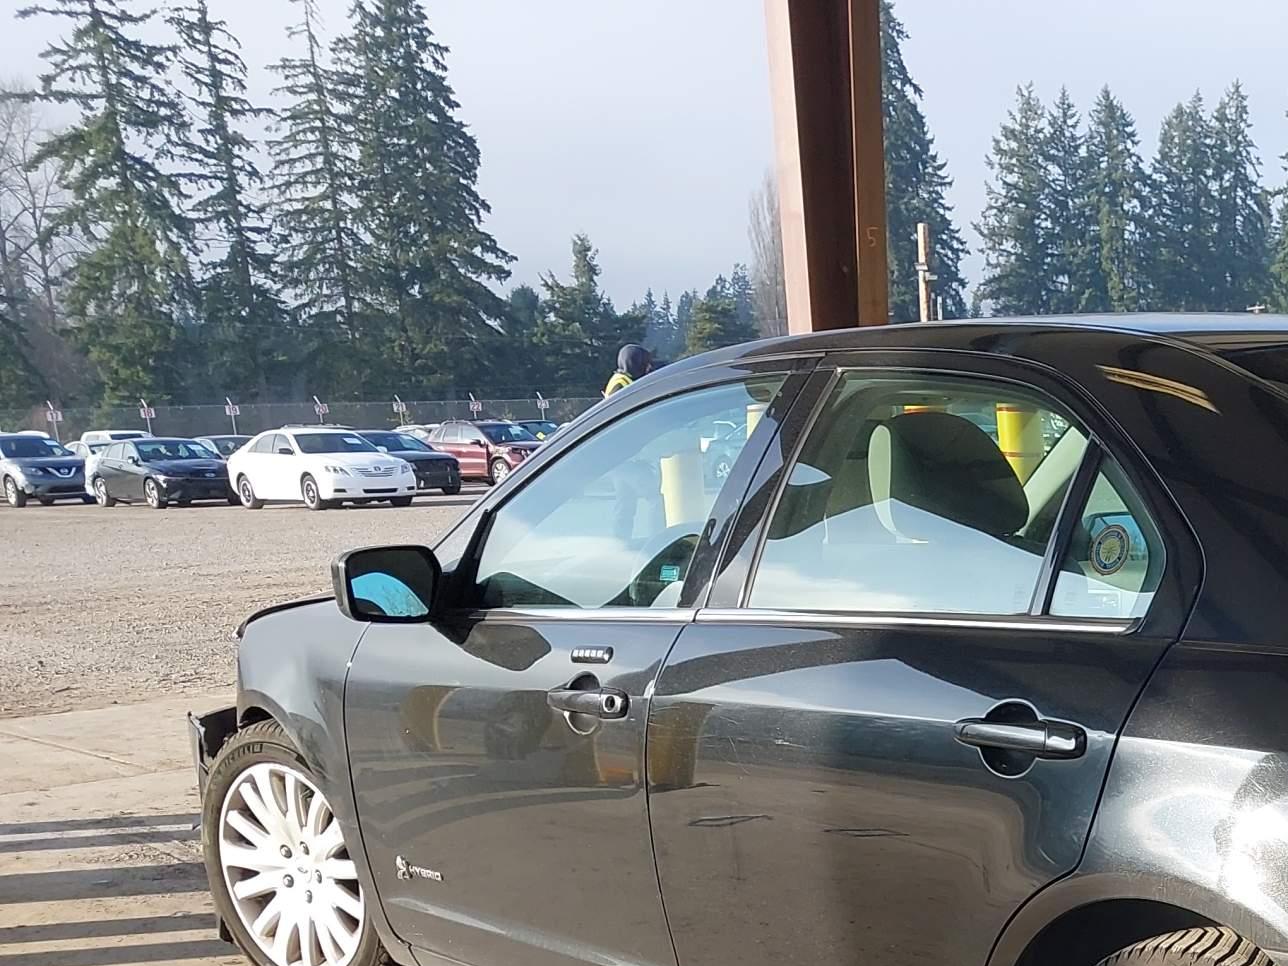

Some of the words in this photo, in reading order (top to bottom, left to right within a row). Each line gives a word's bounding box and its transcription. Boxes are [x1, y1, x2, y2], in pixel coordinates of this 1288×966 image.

[866, 226, 880, 248] 5
[143, 408, 153, 418] 18
[408, 864, 442, 881] HYBRID
